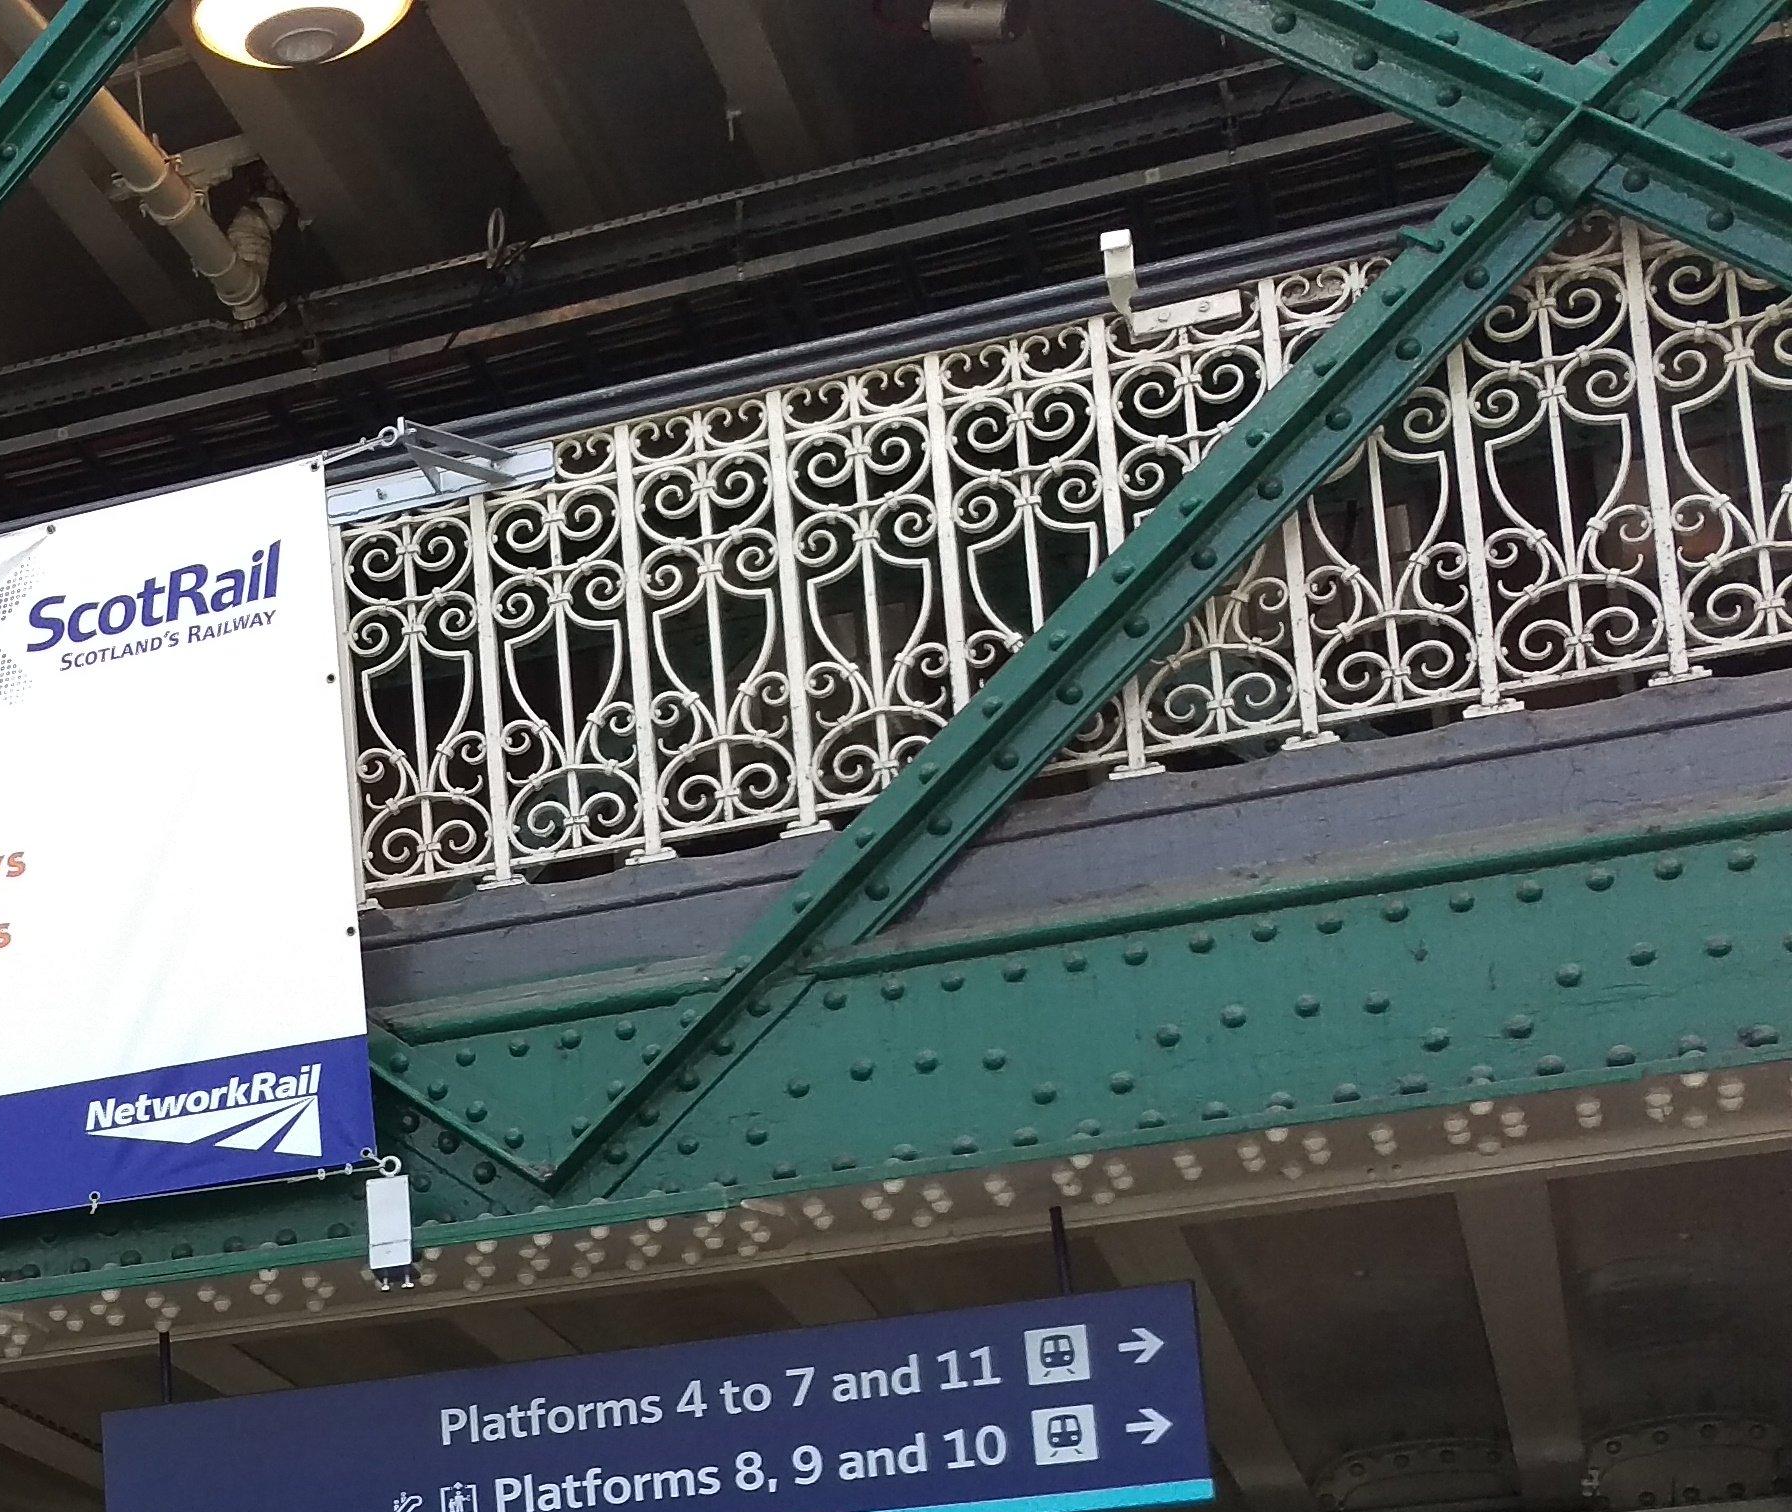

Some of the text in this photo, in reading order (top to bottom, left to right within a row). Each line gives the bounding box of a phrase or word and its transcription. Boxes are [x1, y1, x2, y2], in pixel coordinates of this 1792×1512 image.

[27, 539, 282, 653] ScotRail
[59, 609, 277, 672] SCOTLAND'S RAILWAY
[440, 1346, 1002, 1445] Platforms 4 to 7 and 11
[734, 1450, 777, 1494] 8,
[792, 1444, 822, 1486] 9
[838, 1432, 927, 1481] and
[943, 1425, 1007, 1470] 10
